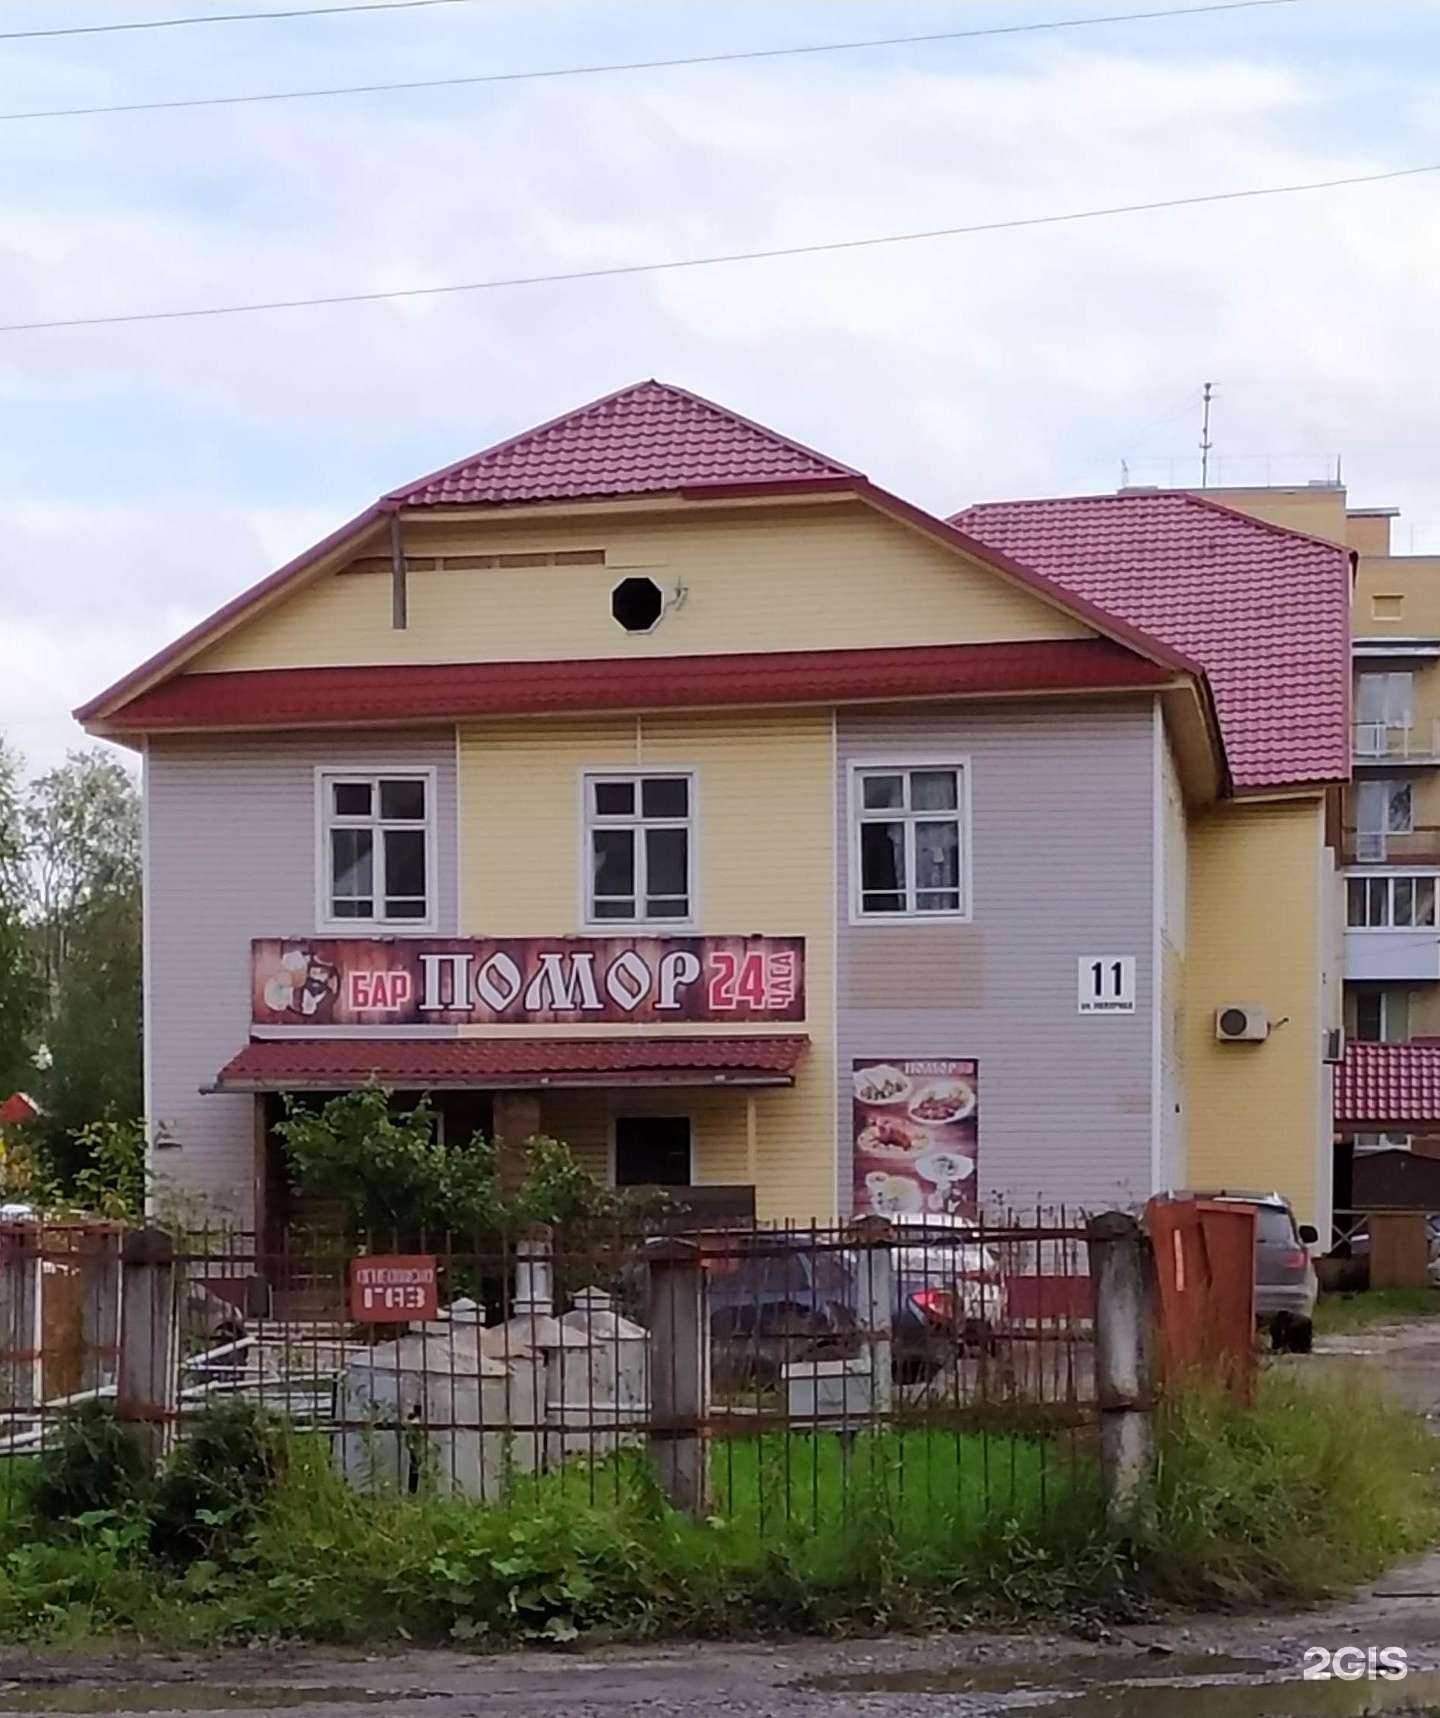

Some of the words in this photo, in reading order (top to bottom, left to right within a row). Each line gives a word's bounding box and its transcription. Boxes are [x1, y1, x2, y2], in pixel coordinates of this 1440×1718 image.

[350, 971, 411, 1010] БАР
[418, 951, 700, 1012] ПОМОР
[709, 951, 766, 1010] 24
[767, 951, 796, 1009] ЧАСА
[1091, 962, 1121, 996] 11
[364, 1287, 425, 1308] ГАЗ
